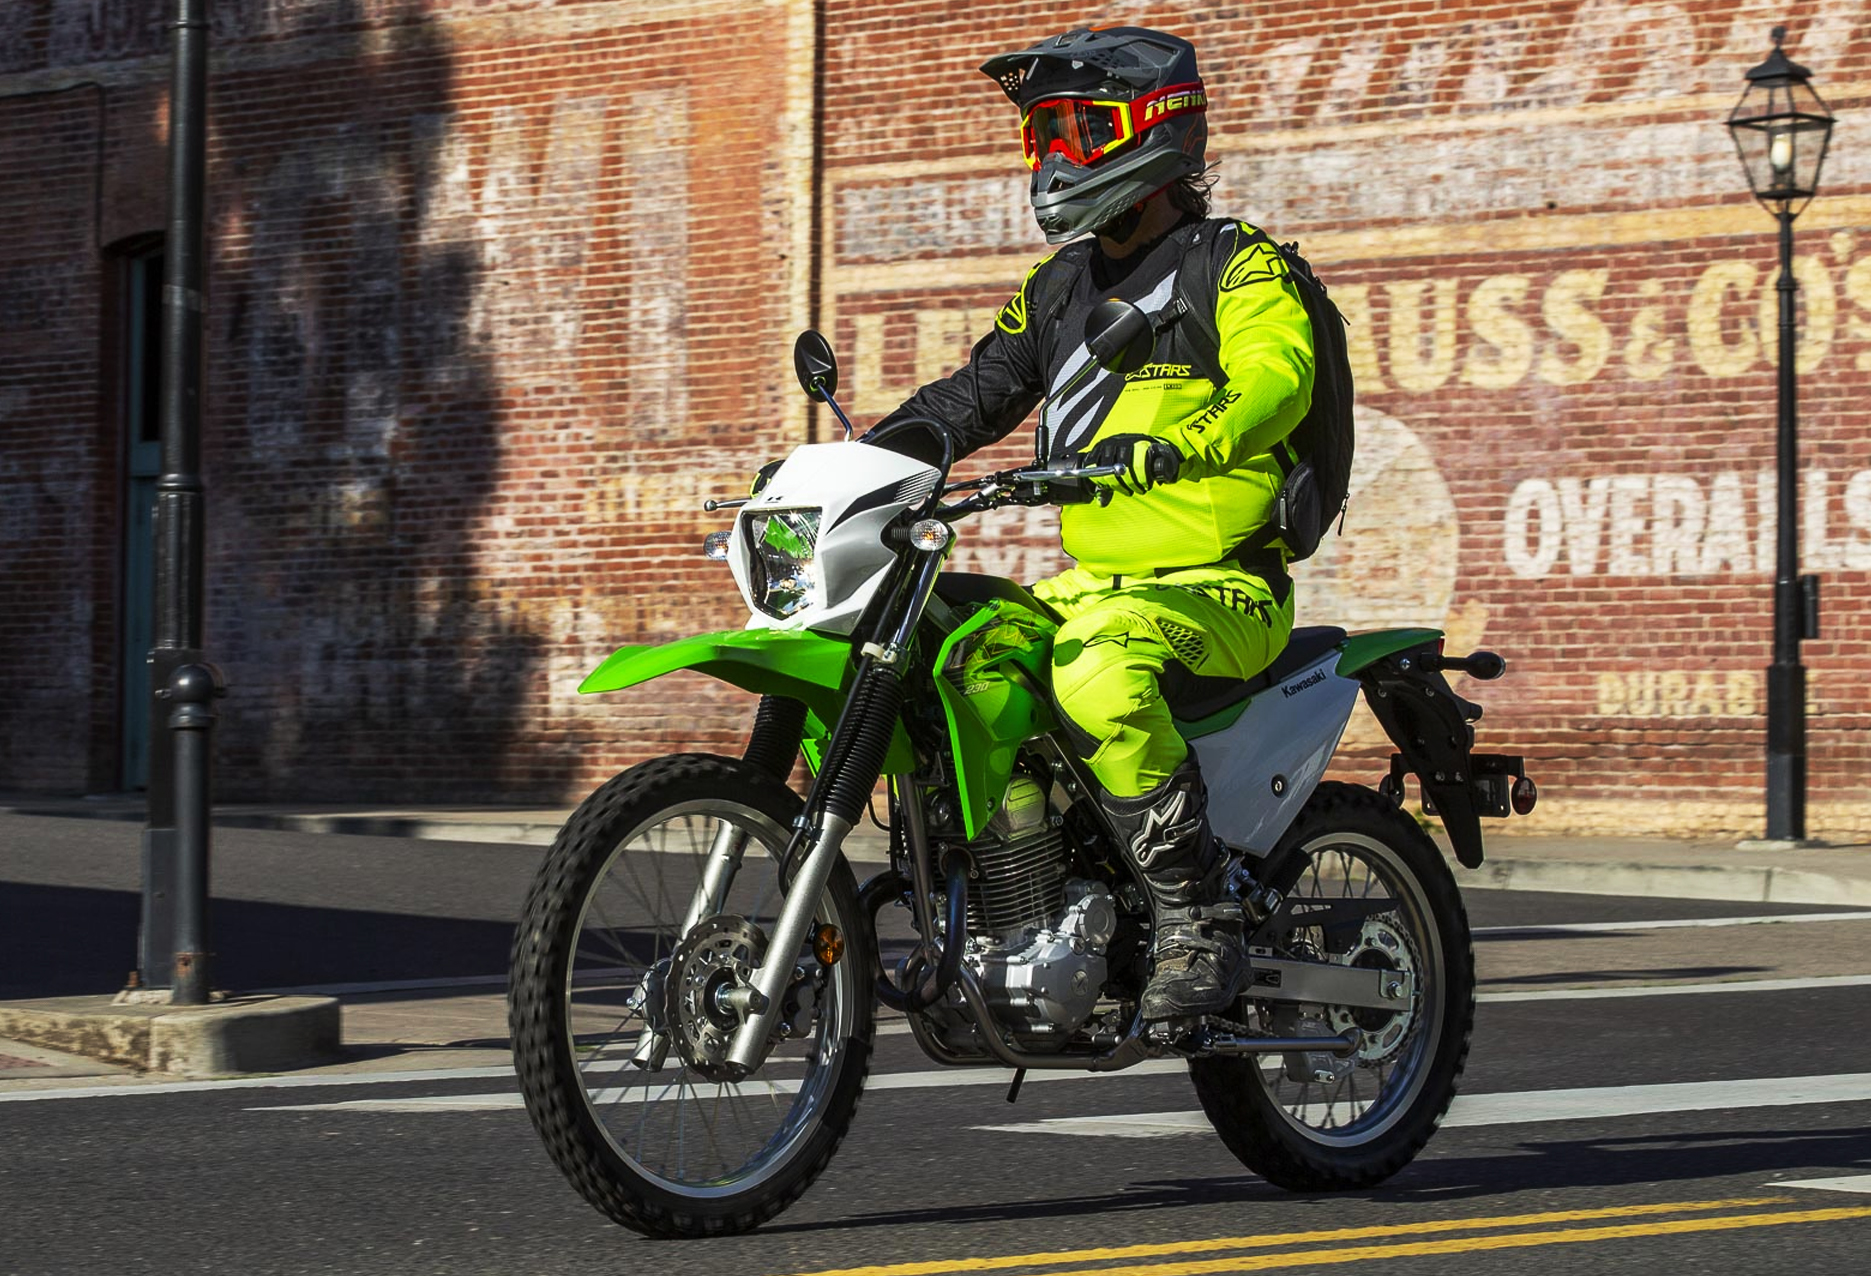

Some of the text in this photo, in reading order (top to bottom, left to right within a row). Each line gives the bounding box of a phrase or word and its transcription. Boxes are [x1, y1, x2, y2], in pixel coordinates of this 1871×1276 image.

[1623, 278, 1675, 380] &
[964, 681, 990, 696] 230
[1281, 668, 1326, 698] Kawasaki
